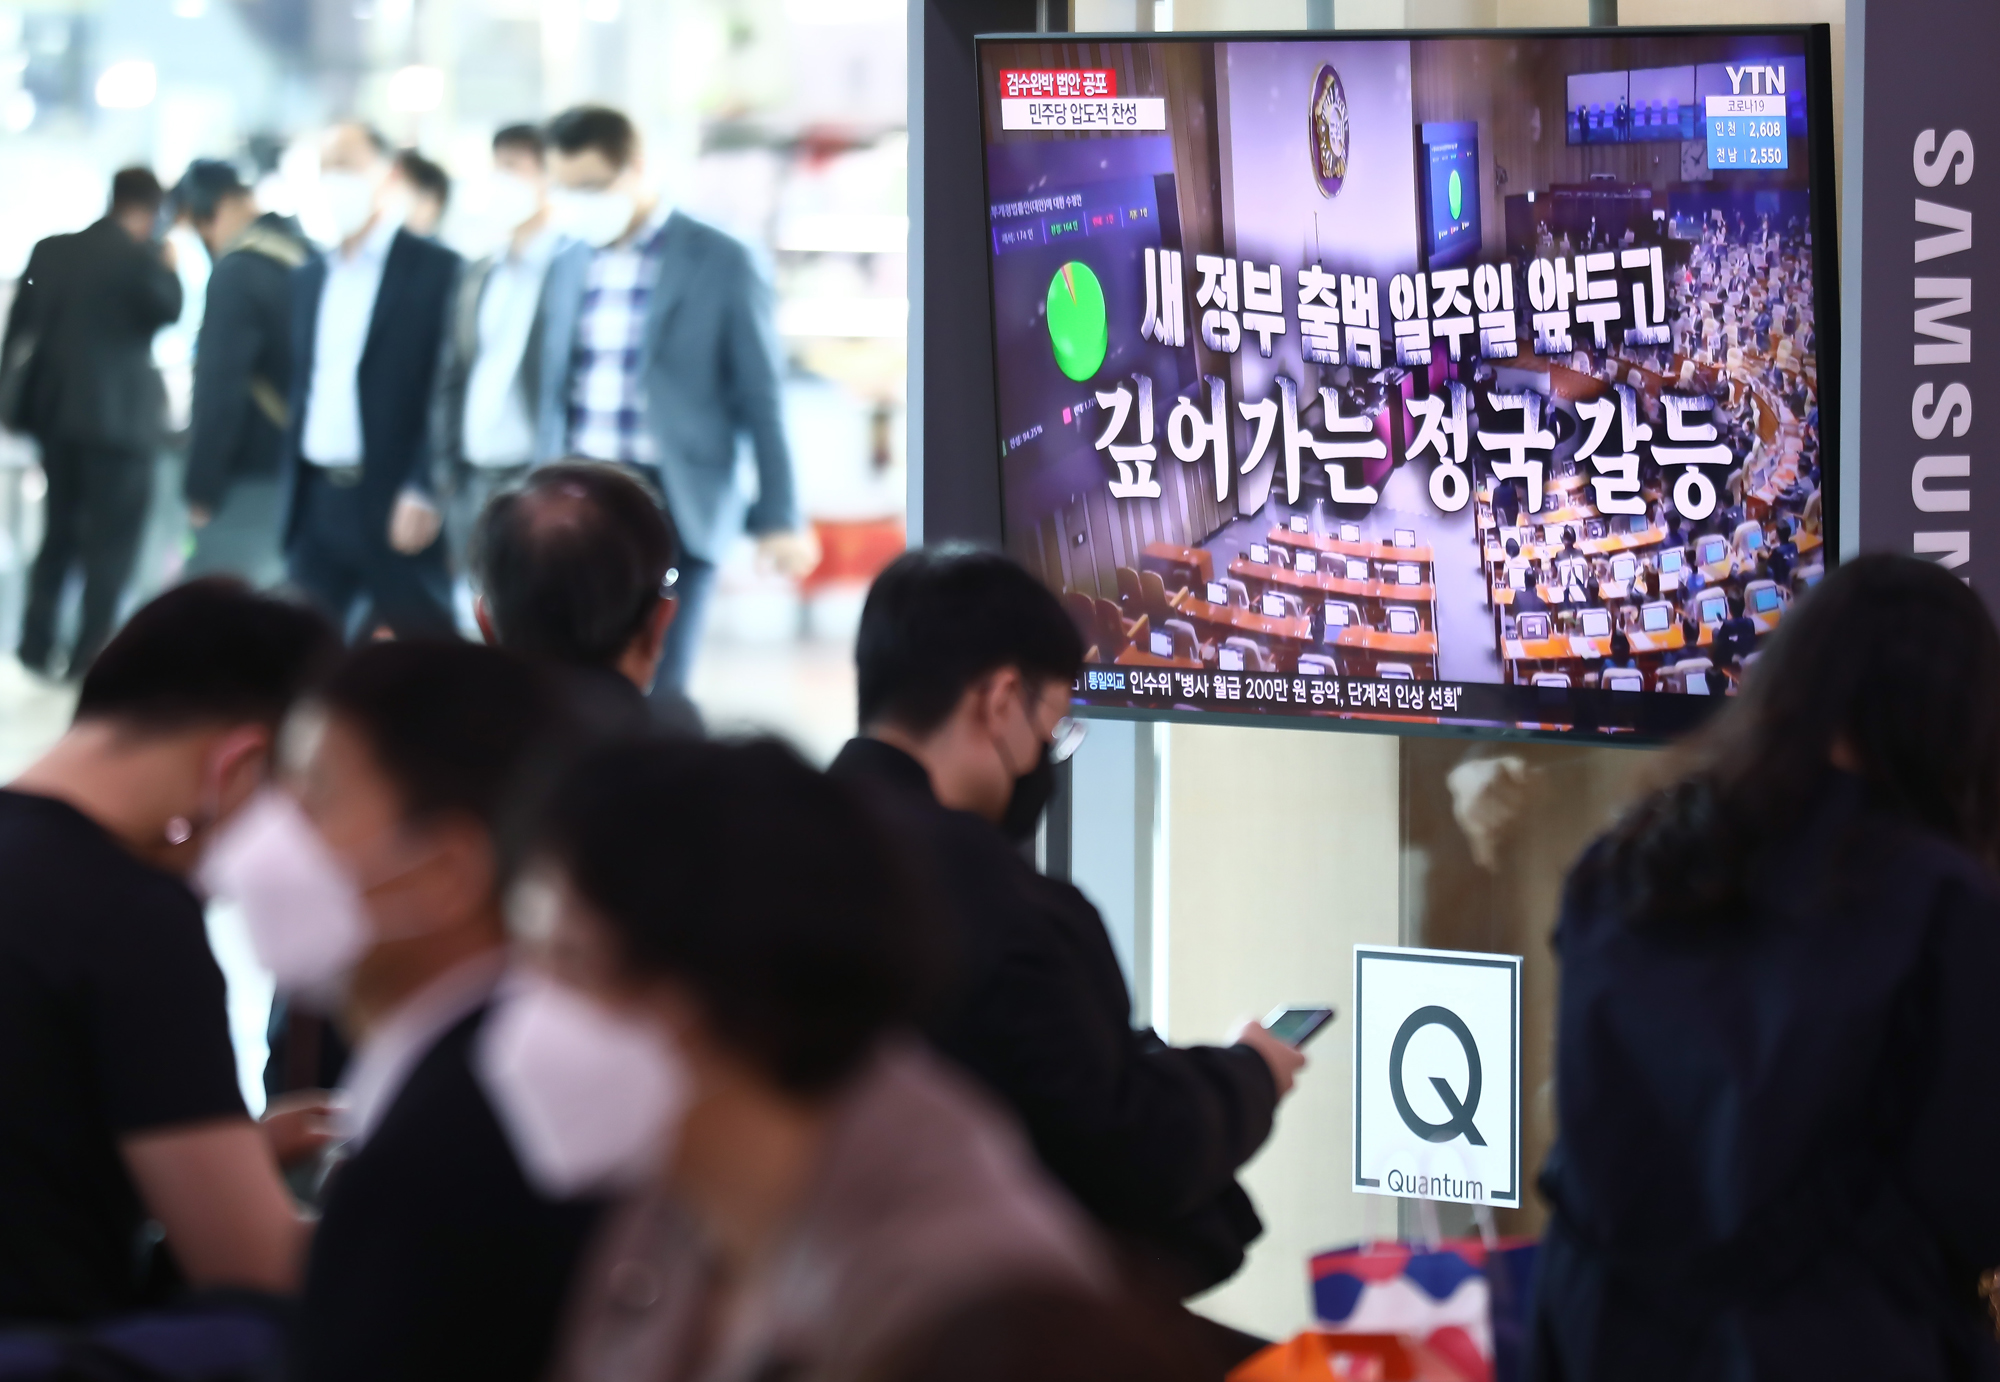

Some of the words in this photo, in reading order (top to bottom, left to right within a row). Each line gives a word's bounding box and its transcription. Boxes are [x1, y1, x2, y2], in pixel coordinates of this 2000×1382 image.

[1006, 72, 1054, 96] 검수완박
[1056, 73, 1081, 96] 법안
[1082, 73, 1108, 96] 공포
[1725, 66, 1786, 95] YTN
[1029, 103, 1067, 125] 민주당
[1070, 103, 1109, 126] 압도적
[1111, 102, 1137, 125] 찬성
[1727, 99, 1765, 113] 코로나19
[1749, 121, 1781, 139] 2,608
[1750, 148, 1782, 165] 2,550
[1141, 247, 1186, 348] 새
[1196, 253, 1286, 358] 정부
[1297, 264, 1382, 369] 출범
[1389, 262, 1519, 366] 일주일
[1527, 246, 1670, 355] 앞두고
[1911, 129, 1974, 588] SAMSUN
[1094, 373, 1387, 506] 깊어가는
[1405, 378, 1556, 512] 정국
[1574, 382, 1733, 521] 갈등
[1088, 671, 1126, 691] 통일외교
[1129, 671, 1172, 697] 인수위
[1175, 672, 1209, 698] "병사
[1213, 675, 1242, 700] 월급
[1245, 678, 1288, 703] 200만
[1292, 679, 1307, 704] 원
[1310, 680, 1344, 707] 공약,
[1348, 682, 1392, 708] 단계적
[1395, 684, 1424, 711] 인상
[1428, 686, 1463, 712] 선회"
[1389, 1005, 1488, 1147] Q
[1387, 1169, 1483, 1200] Quantum
